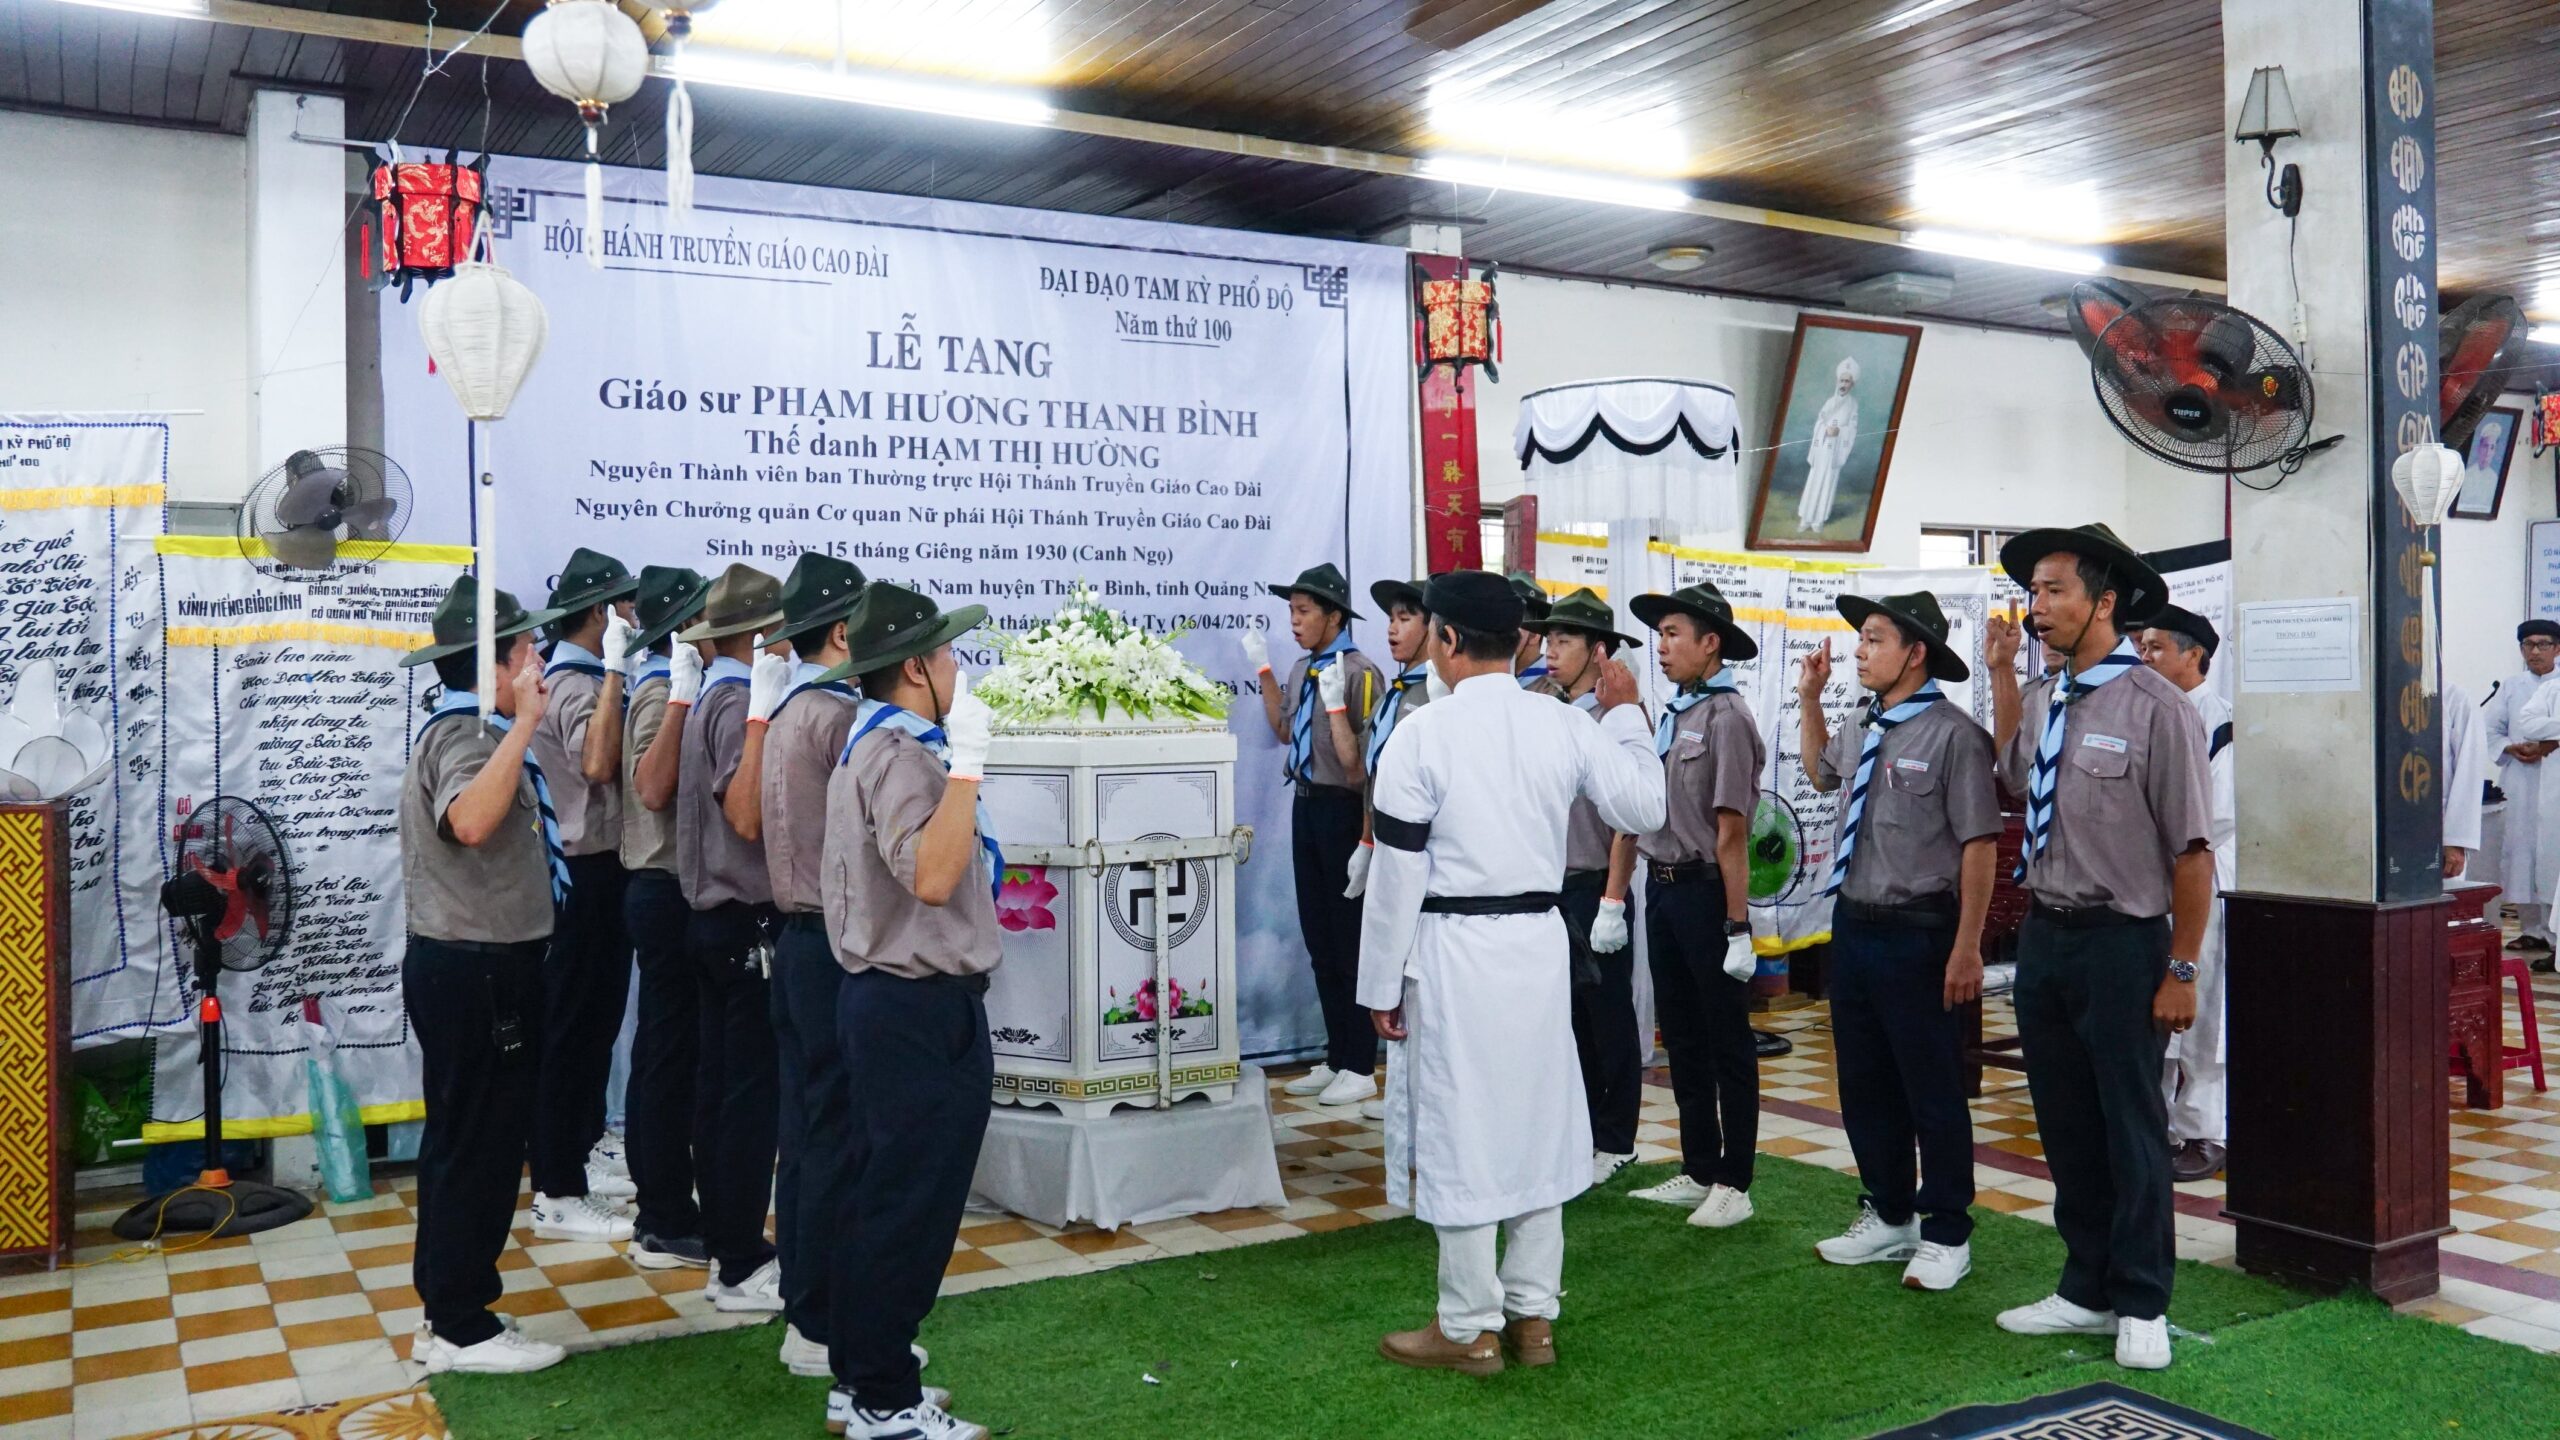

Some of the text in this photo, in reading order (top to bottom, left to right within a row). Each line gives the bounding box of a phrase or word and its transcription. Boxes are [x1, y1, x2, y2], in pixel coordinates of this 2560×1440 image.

[544, 218, 889, 279] HỘI HÁNH TRUYỀN GIÁO CAO ĐÀI
[1040, 267, 1294, 317] ĐẠI ĐẠO TAM KỲ PHỔ ĐỘ
[1115, 310, 1232, 342] Năm thứ 100
[866, 313, 1053, 379] LỄ TANG
[600, 377, 1259, 438] Giáo sư PHẠM HƯƠNG THANH BÌNH
[0, 454, 16, 467] HỨ
[744, 424, 1160, 470] Thế danh PHẠM THỊ HƯỜNG
[589, 459, 1262, 497] Nguyên Thành viên ban Thường trực Hội Thánh Truyền Giáo Cao Đài
[574, 498, 1271, 531] Nguyên Chưởng quản Cơ quan Nữ phái Hội Thánh Truyền Giáo Cao Đài
[706, 539, 753, 557] Sinh
[825, 541, 847, 557] 15
[853, 542, 910, 563] tháng
[915, 542, 973, 563] Giêng
[979, 545, 1018, 560] năm
[1026, 544, 1067, 561] 1930
[1072, 545, 1127, 564] (Canh
[1133, 546, 1173, 566] Ngọ)
[178, 592, 208, 617] KÍNH
[928, 578, 974, 595] Nam
[980, 579, 1035, 600] huyện
[1105, 580, 1151, 598] Bình,
[1156, 580, 1189, 596] tỉnh
[1195, 580, 1249, 599] Quảng
